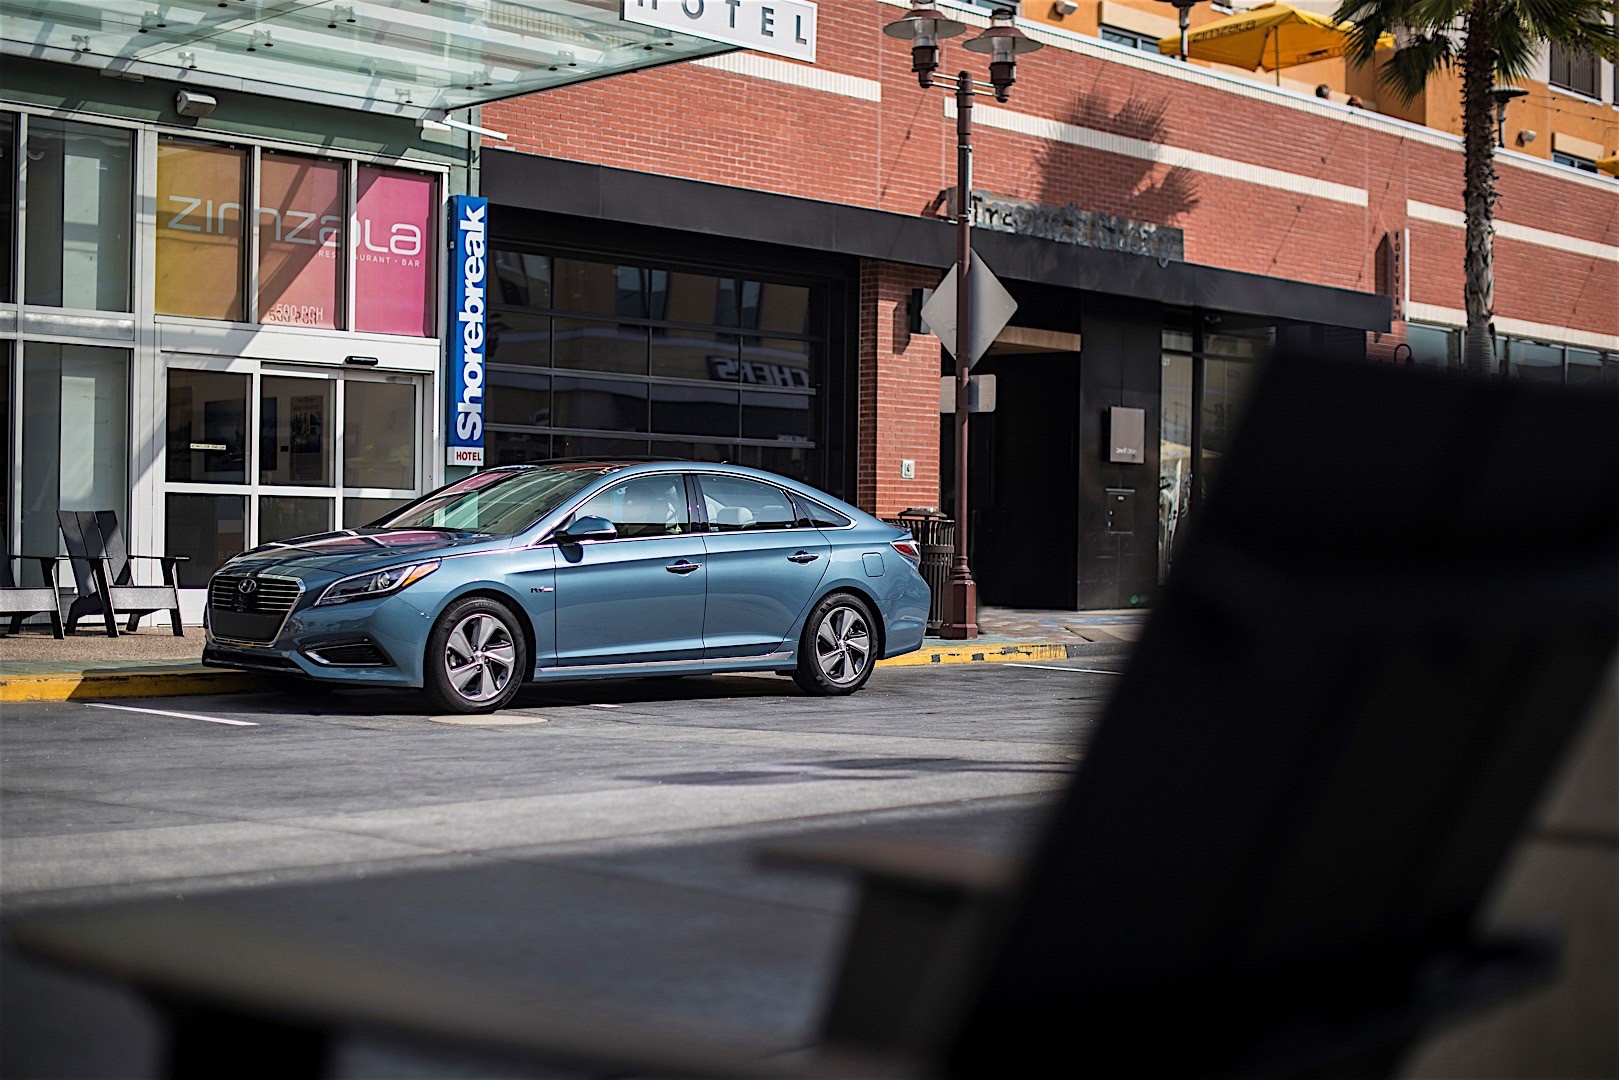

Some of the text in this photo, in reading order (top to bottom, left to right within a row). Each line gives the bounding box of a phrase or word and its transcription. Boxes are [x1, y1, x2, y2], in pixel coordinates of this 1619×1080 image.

[319, 249, 420, 268] RESURANT BAR
[301, 305, 324, 321] PCH
[456, 204, 485, 442] Shorebreak
[456, 451, 482, 461] HOTEL
